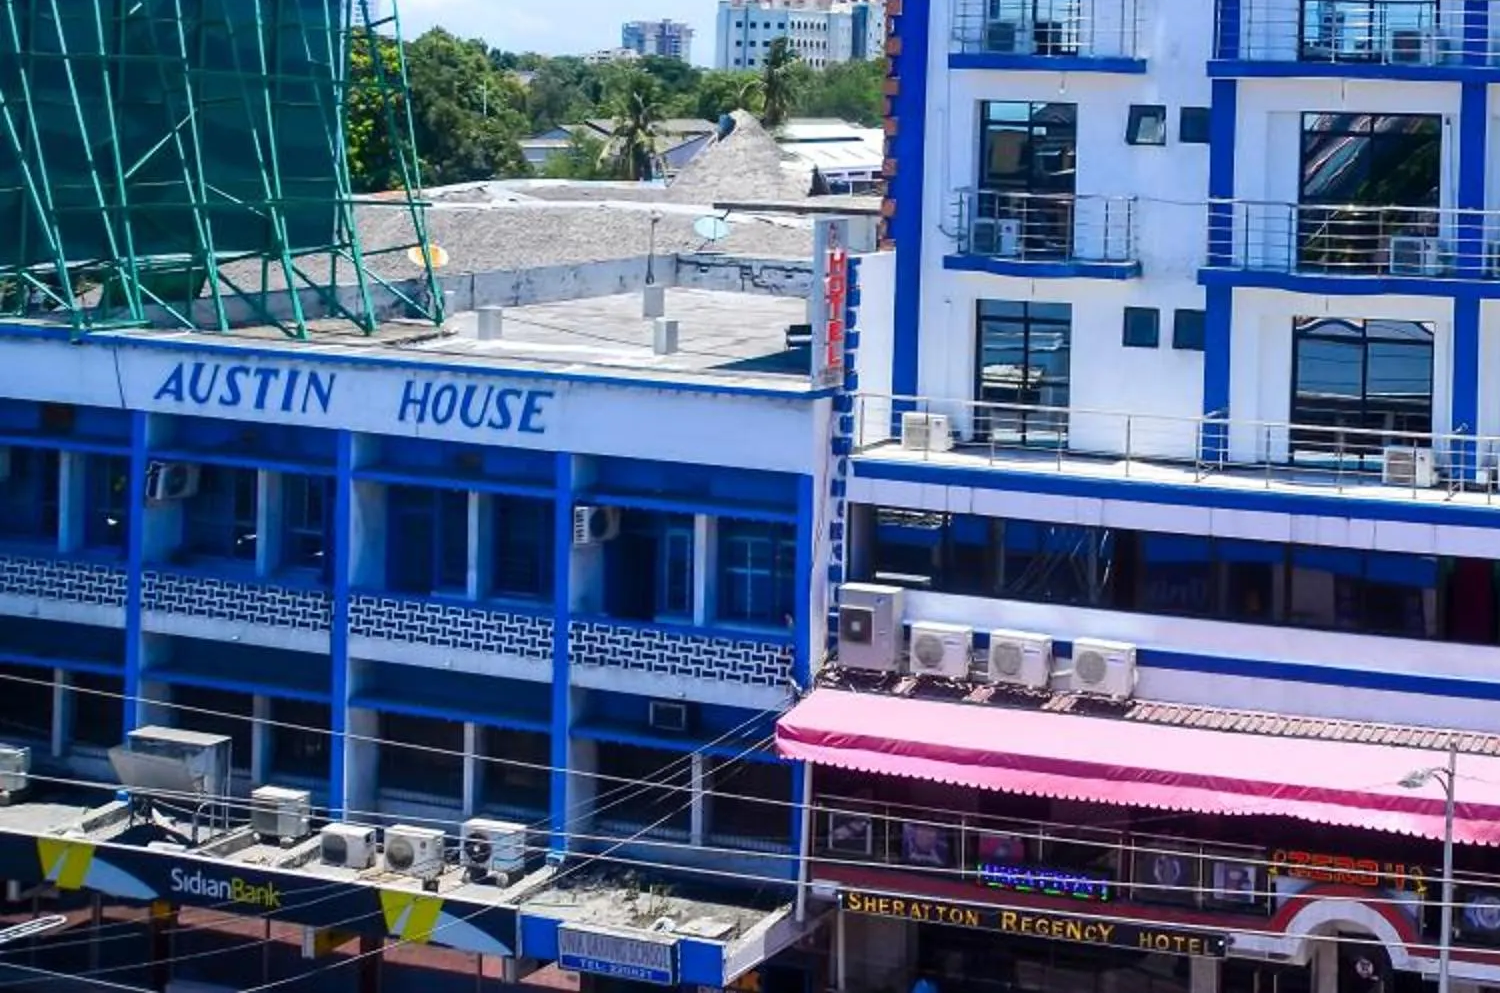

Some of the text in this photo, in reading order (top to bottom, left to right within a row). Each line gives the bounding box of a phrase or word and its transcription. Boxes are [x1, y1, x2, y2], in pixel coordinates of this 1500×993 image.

[825, 248, 845, 368] HOTEL
[153, 362, 554, 434] AUSTIN HOUSE
[171, 867, 281, 907] SidianBank
[1001, 910, 1115, 943] REGENCY
[1138, 932, 1217, 956] HOTEL
